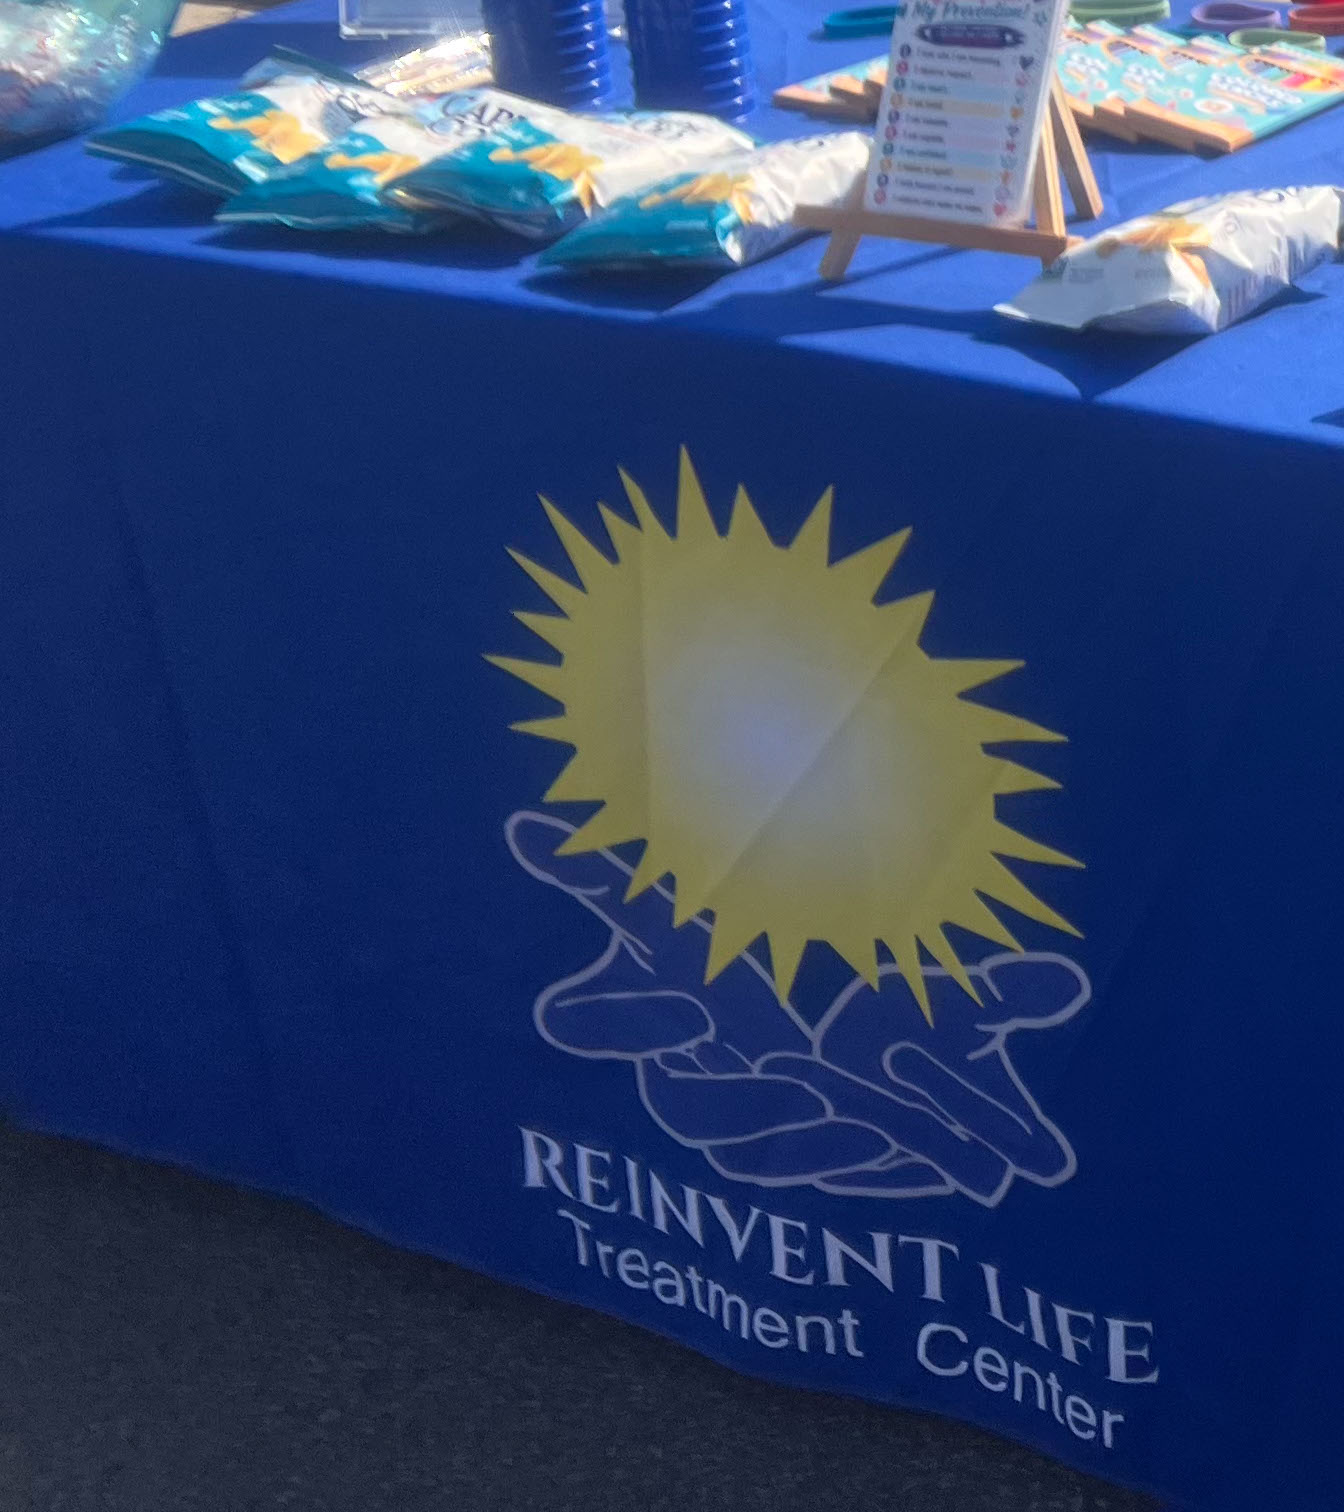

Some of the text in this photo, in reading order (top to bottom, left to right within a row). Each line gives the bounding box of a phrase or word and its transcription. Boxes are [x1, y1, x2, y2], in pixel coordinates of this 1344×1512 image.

[912, 1, 1031, 22] My Prevention!
[517, 1126, 1160, 1386] REINVENT LIFE
[557, 1208, 1125, 1450] Treatment Center
